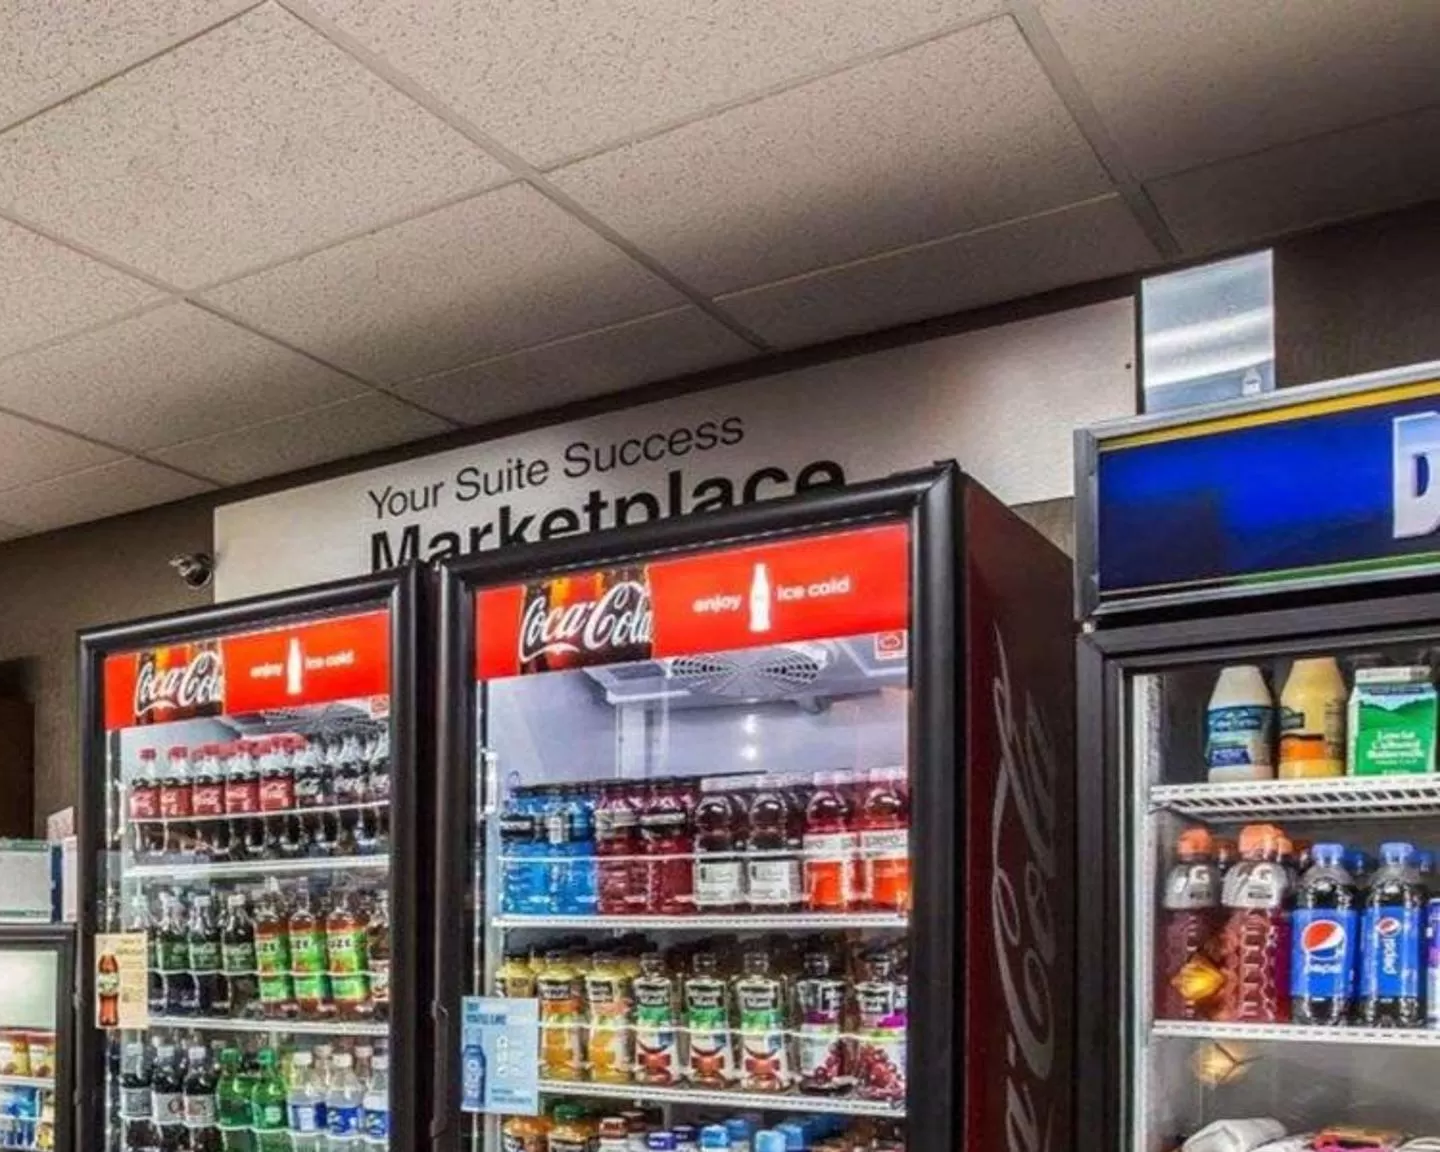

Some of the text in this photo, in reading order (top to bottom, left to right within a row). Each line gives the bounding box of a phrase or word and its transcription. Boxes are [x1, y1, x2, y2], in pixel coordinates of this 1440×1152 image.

[368, 416, 744, 519] Your Suite Success
[692, 593, 742, 613] enjoy
[807, 576, 851, 597] cold
